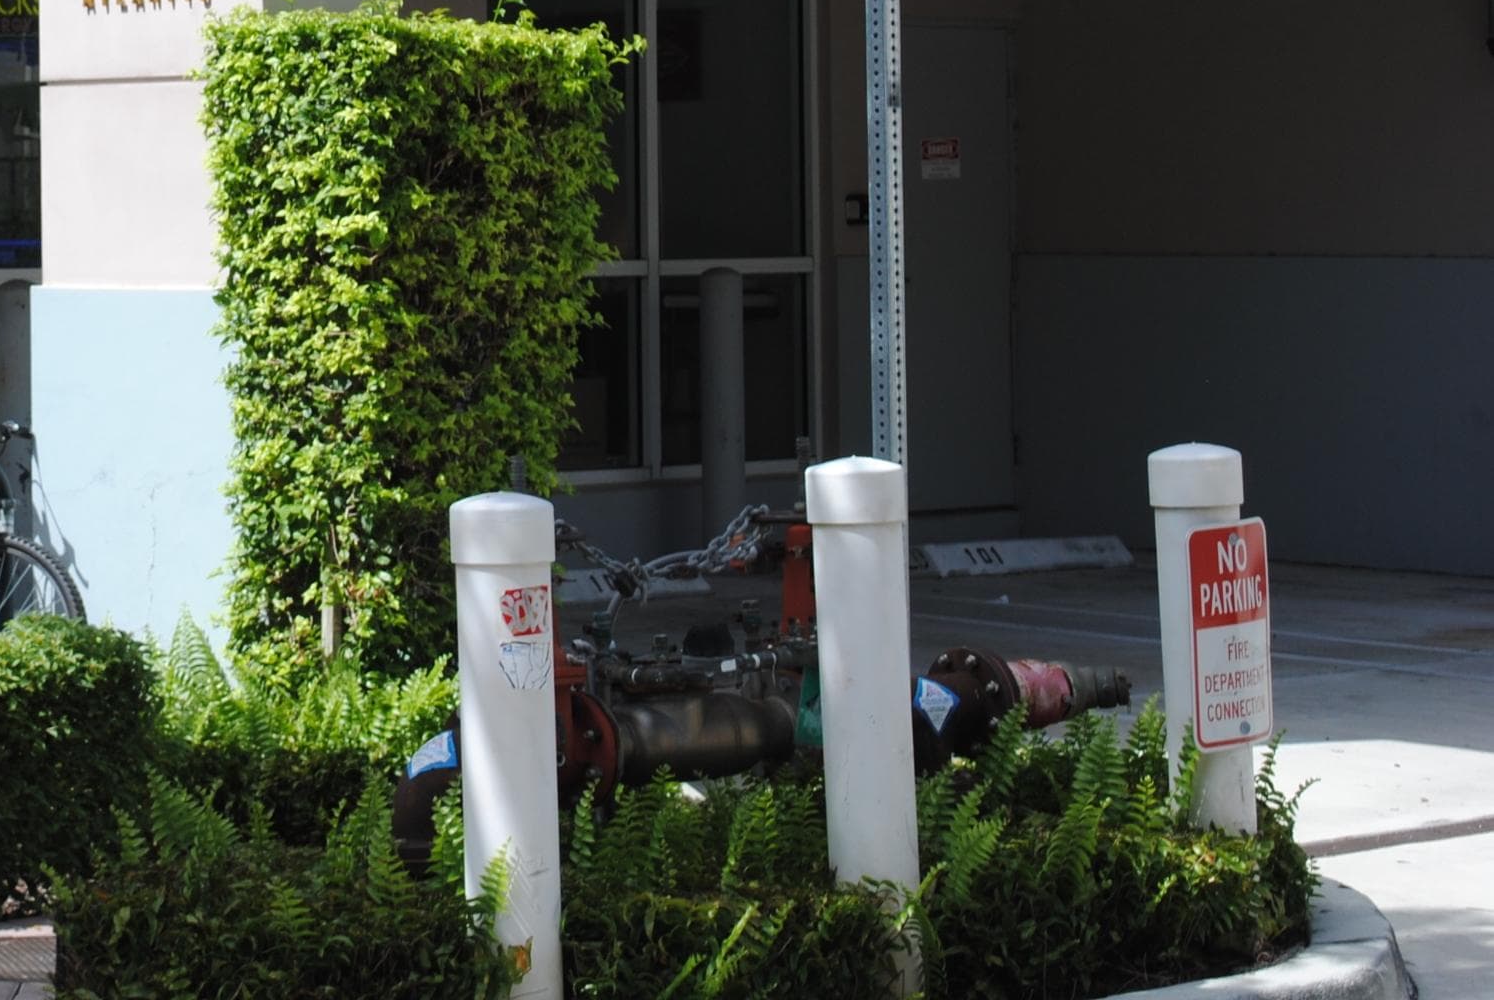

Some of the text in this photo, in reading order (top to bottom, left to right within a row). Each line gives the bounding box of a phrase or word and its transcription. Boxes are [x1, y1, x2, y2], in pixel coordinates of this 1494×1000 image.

[964, 546, 1004, 565] 101
[1217, 537, 1248, 575] NO
[1200, 574, 1263, 617] PARKING
[1227, 640, 1250, 662] FIRE
[1204, 664, 1265, 694] DEPARTMENT
